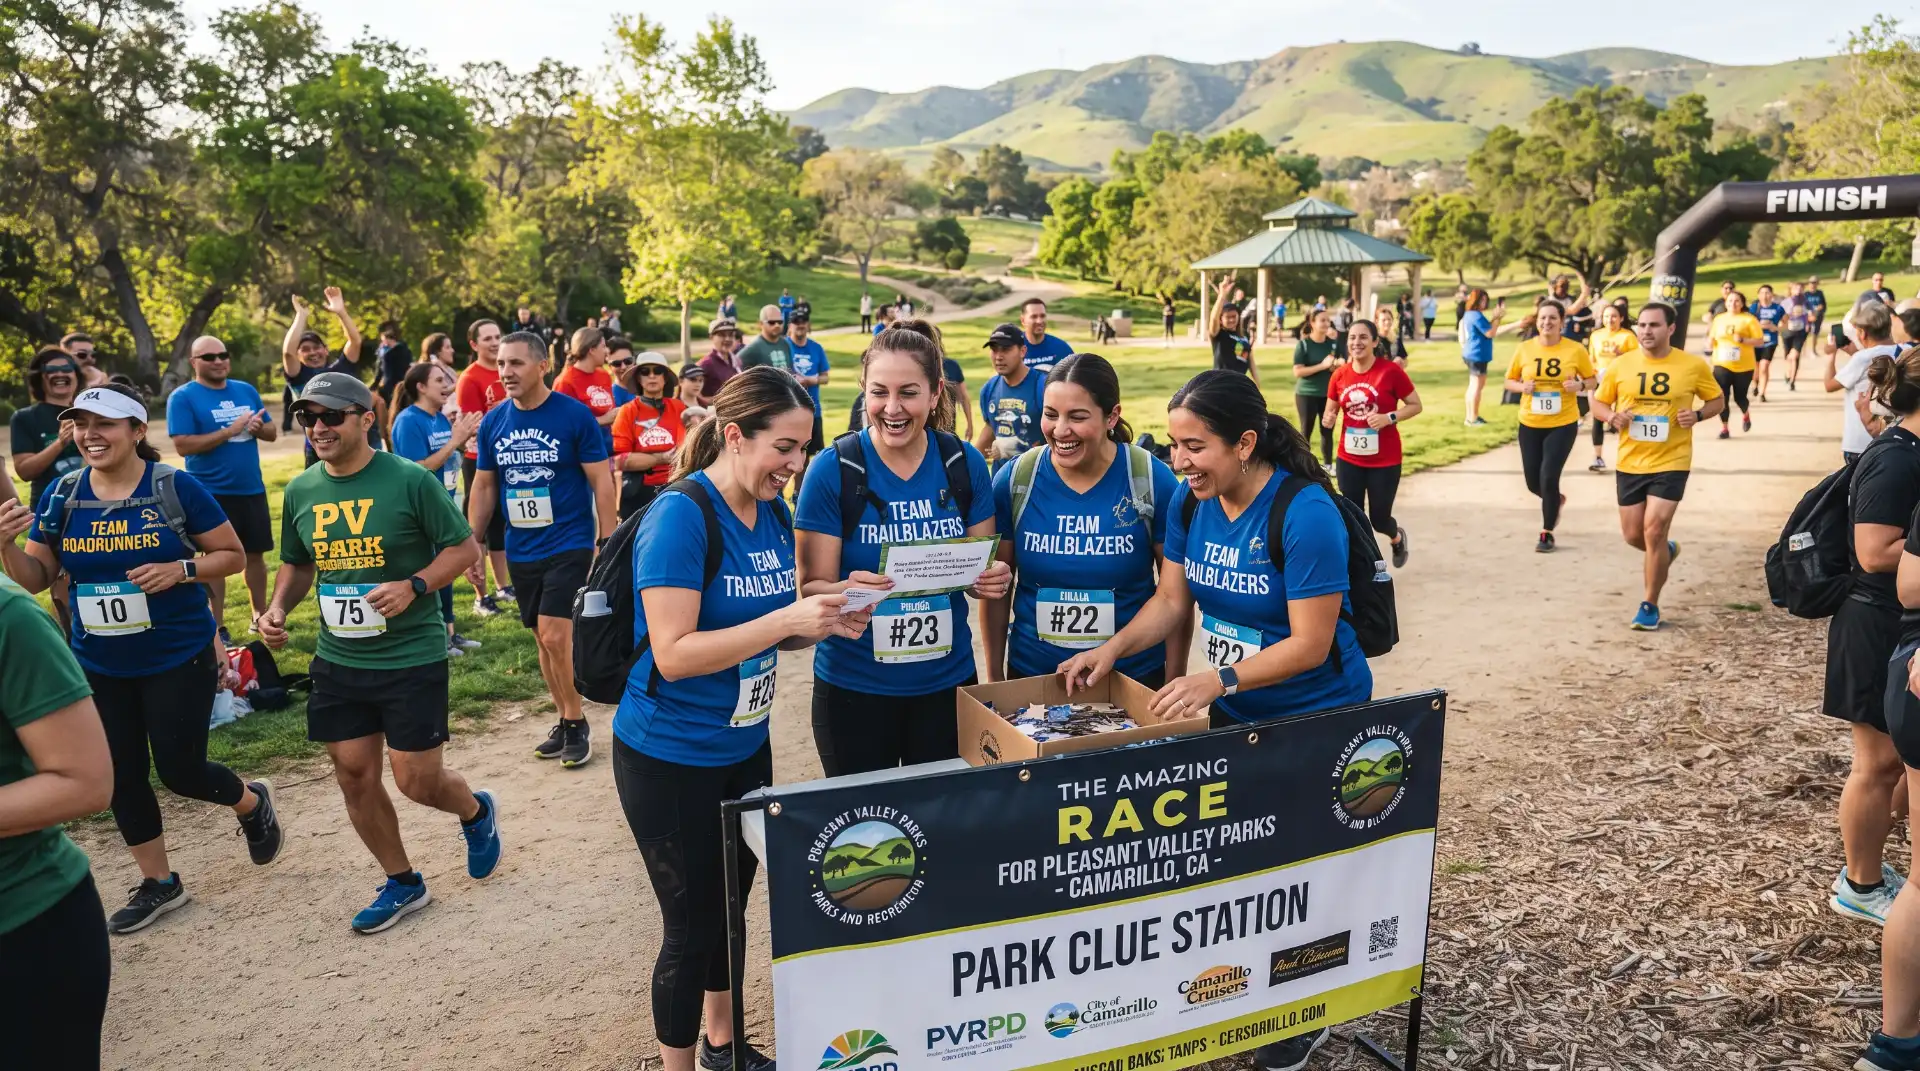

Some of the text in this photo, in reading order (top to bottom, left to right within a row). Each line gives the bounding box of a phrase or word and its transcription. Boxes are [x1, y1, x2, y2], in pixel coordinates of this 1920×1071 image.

[1766, 184, 1888, 214] FINISH
[1534, 357, 1562, 377] 18
[1637, 372, 1670, 396] 18
[1540, 399, 1553, 410] 18
[1642, 424, 1658, 438] 18
[496, 449, 559, 466] CRUISERS
[312, 499, 374, 540] PV
[517, 500, 539, 519] 18
[889, 499, 933, 521] TEAM
[91, 519, 128, 536] TEAM
[859, 516, 964, 544] TRAILBLAZERS
[1057, 515, 1100, 534] TEAM
[62, 532, 160, 553] ROADRUNNERS
[312, 536, 384, 559] PARK
[1024, 531, 1134, 556] TRAILBLAZERS
[1203, 541, 1240, 569] TEAM
[747, 549, 782, 573] TEAM
[723, 568, 796, 598] TRAILBLAZE
[1184, 556, 1270, 595] RAILBLAZERS
[96, 598, 128, 623] 10
[334, 599, 364, 625] 75
[1050, 605, 1099, 634] #22
[889, 614, 939, 648] #23
[1208, 635, 1244, 666] #22
[748, 670, 777, 712] #23
[1365, 724, 1398, 738] VALLEY
[1057, 758, 1228, 801] THE AMAZING
[1058, 781, 1228, 845] RACE
[853, 805, 899, 820] VALLEY
[898, 814, 928, 848] PARKS
[998, 815, 1277, 886] FOR PLEASANT VALLEY PARKS
[1069, 859, 1180, 898] CAMARILLO,
[1186, 853, 1209, 877] CA
[839, 912, 863, 925] AND
[952, 881, 1309, 998] PARK CLUE STATION
[1177, 965, 1252, 994] Camarillo
[1186, 980, 1248, 1005] Cruisers
[1080, 997, 1158, 1024] Camarillo
[1087, 996, 1121, 1010] City of
[927, 1012, 1027, 1049] PVRPD
[1167, 1037, 1207, 1061] TANPS
